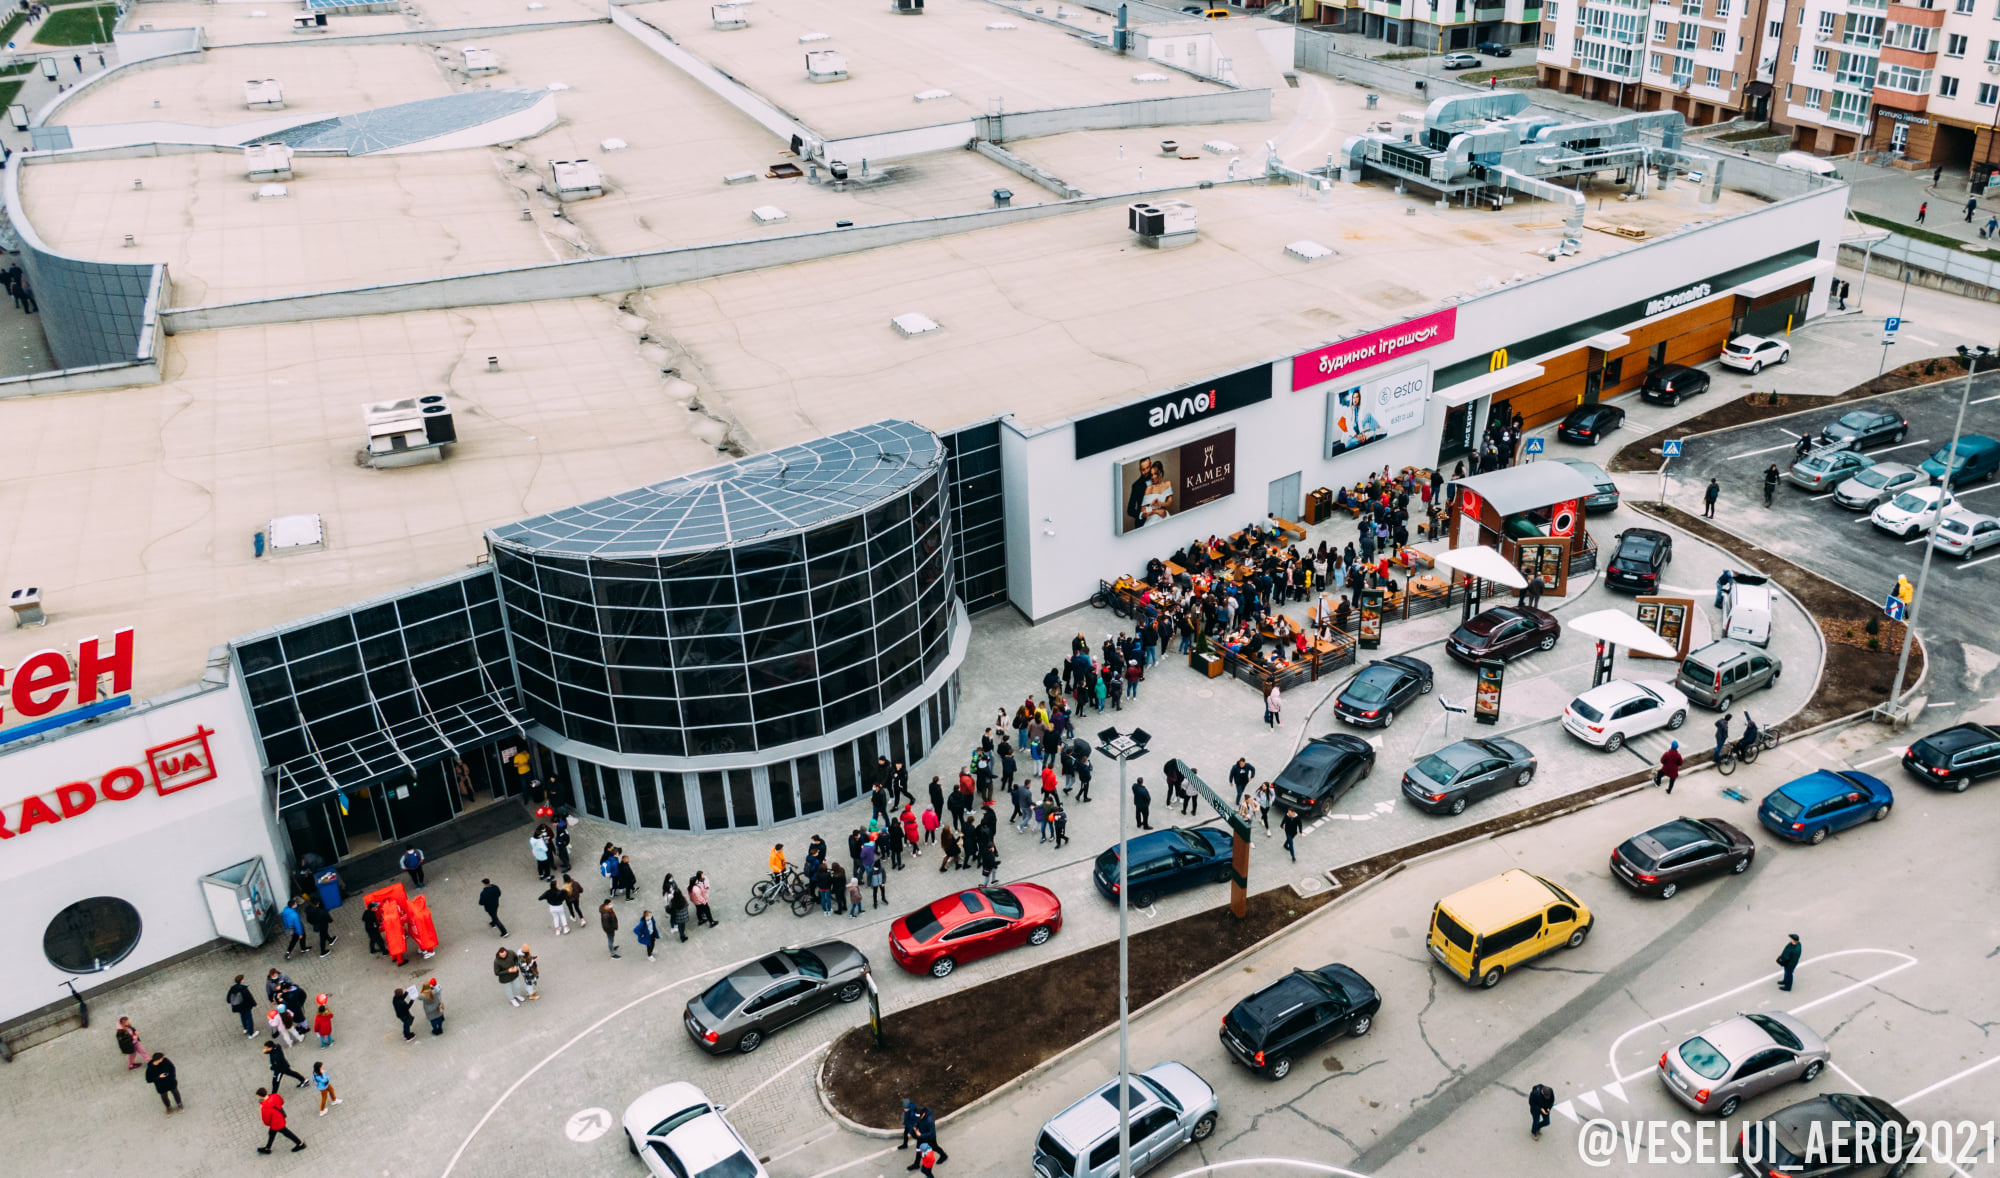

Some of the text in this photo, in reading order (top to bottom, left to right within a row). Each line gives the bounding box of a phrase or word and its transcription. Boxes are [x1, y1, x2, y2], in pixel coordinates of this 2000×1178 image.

[1645, 283, 1711, 317] McDonald's
[1887, 318, 1897, 330] P
[1318, 325, 1438, 374] будинок іграшок
[1393, 379, 1423, 399] estro
[1186, 463, 1231, 488] КАМЕЯ
[0, 626, 134, 725] ен
[160, 752, 203, 776] UA
